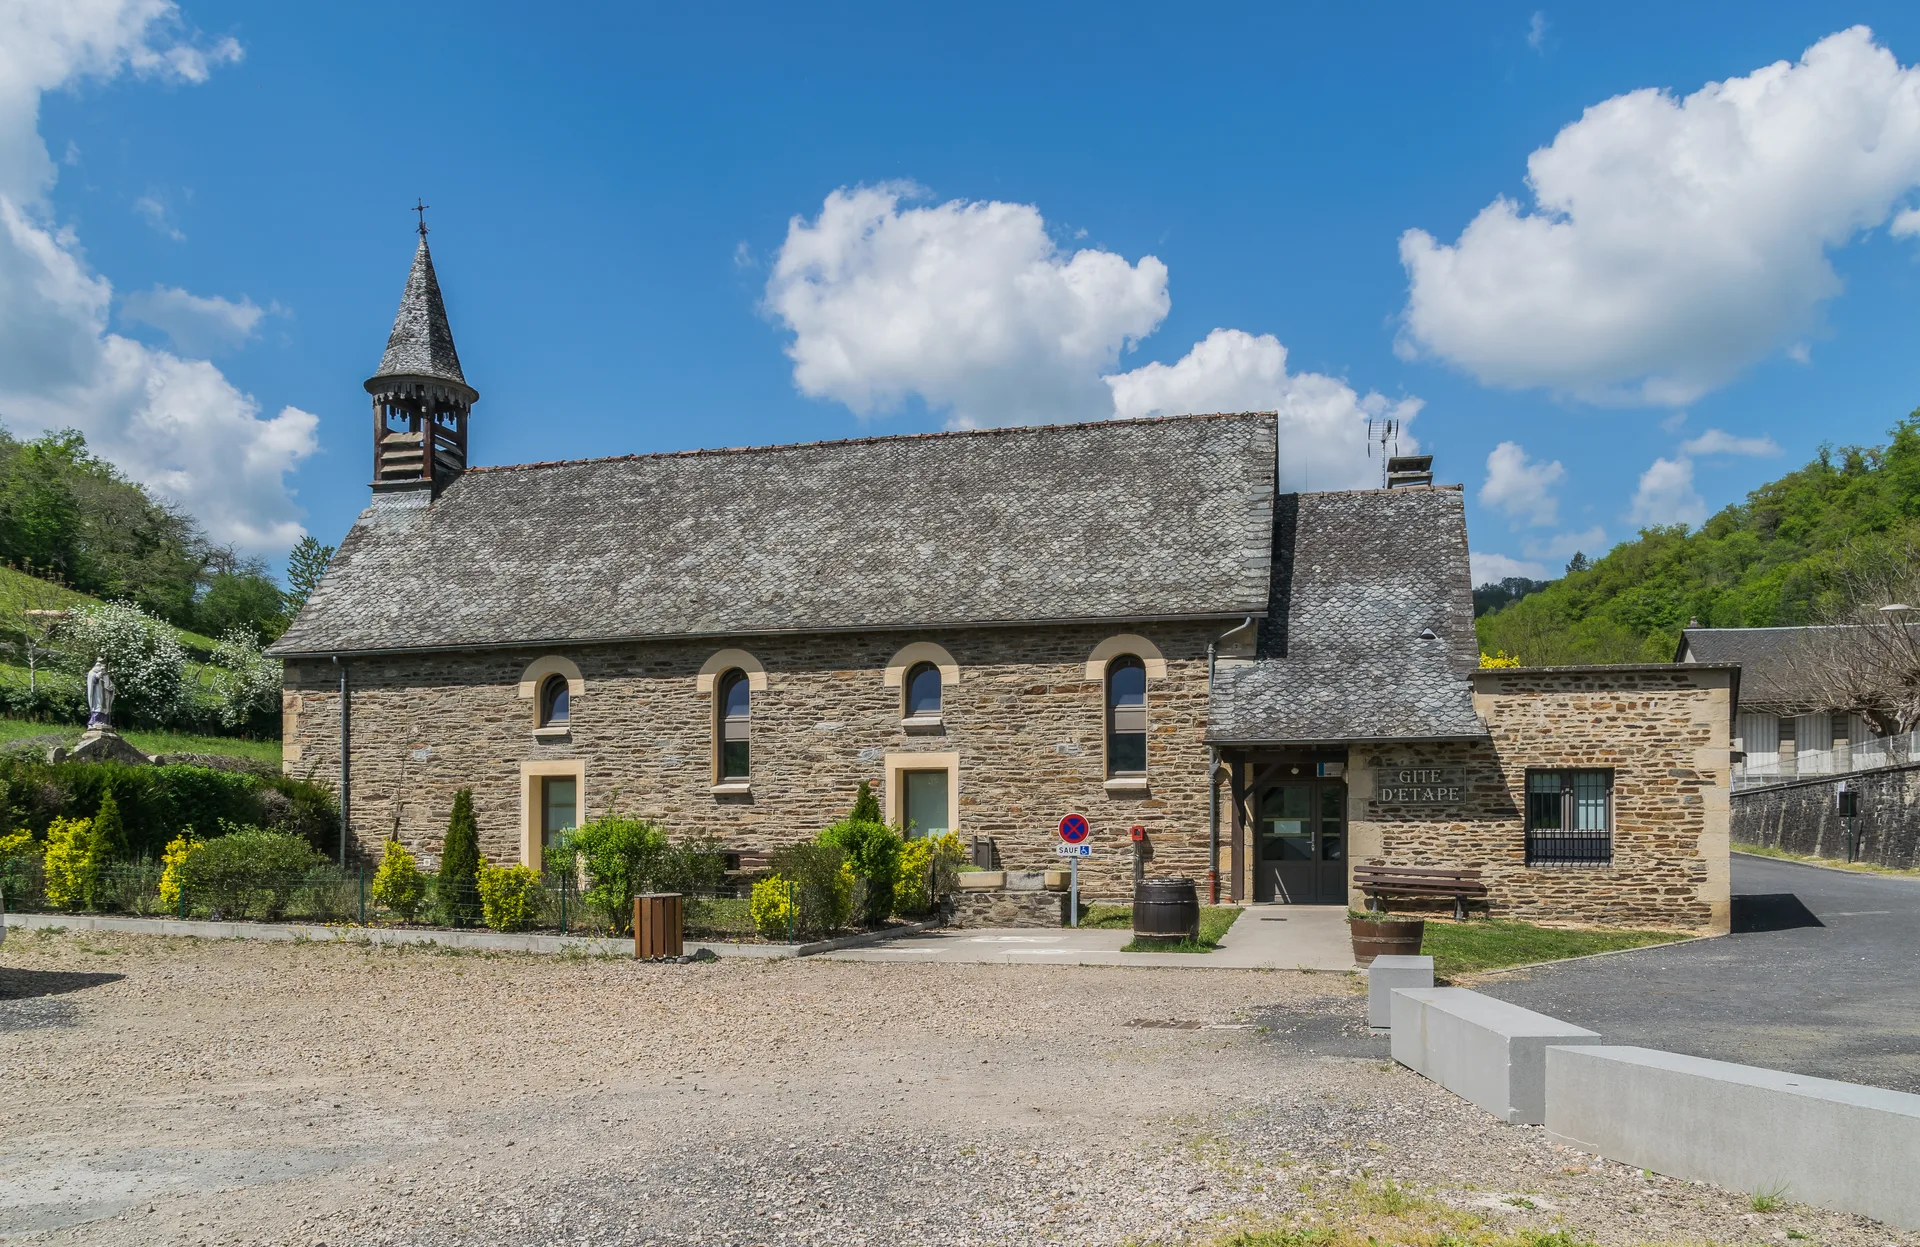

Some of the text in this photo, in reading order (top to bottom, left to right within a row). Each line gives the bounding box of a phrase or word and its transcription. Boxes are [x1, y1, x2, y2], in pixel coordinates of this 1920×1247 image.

[1399, 769, 1442, 784] GITE
[1381, 787, 1460, 802] D'ETAPE
[1058, 846, 1079, 854] SAUF
